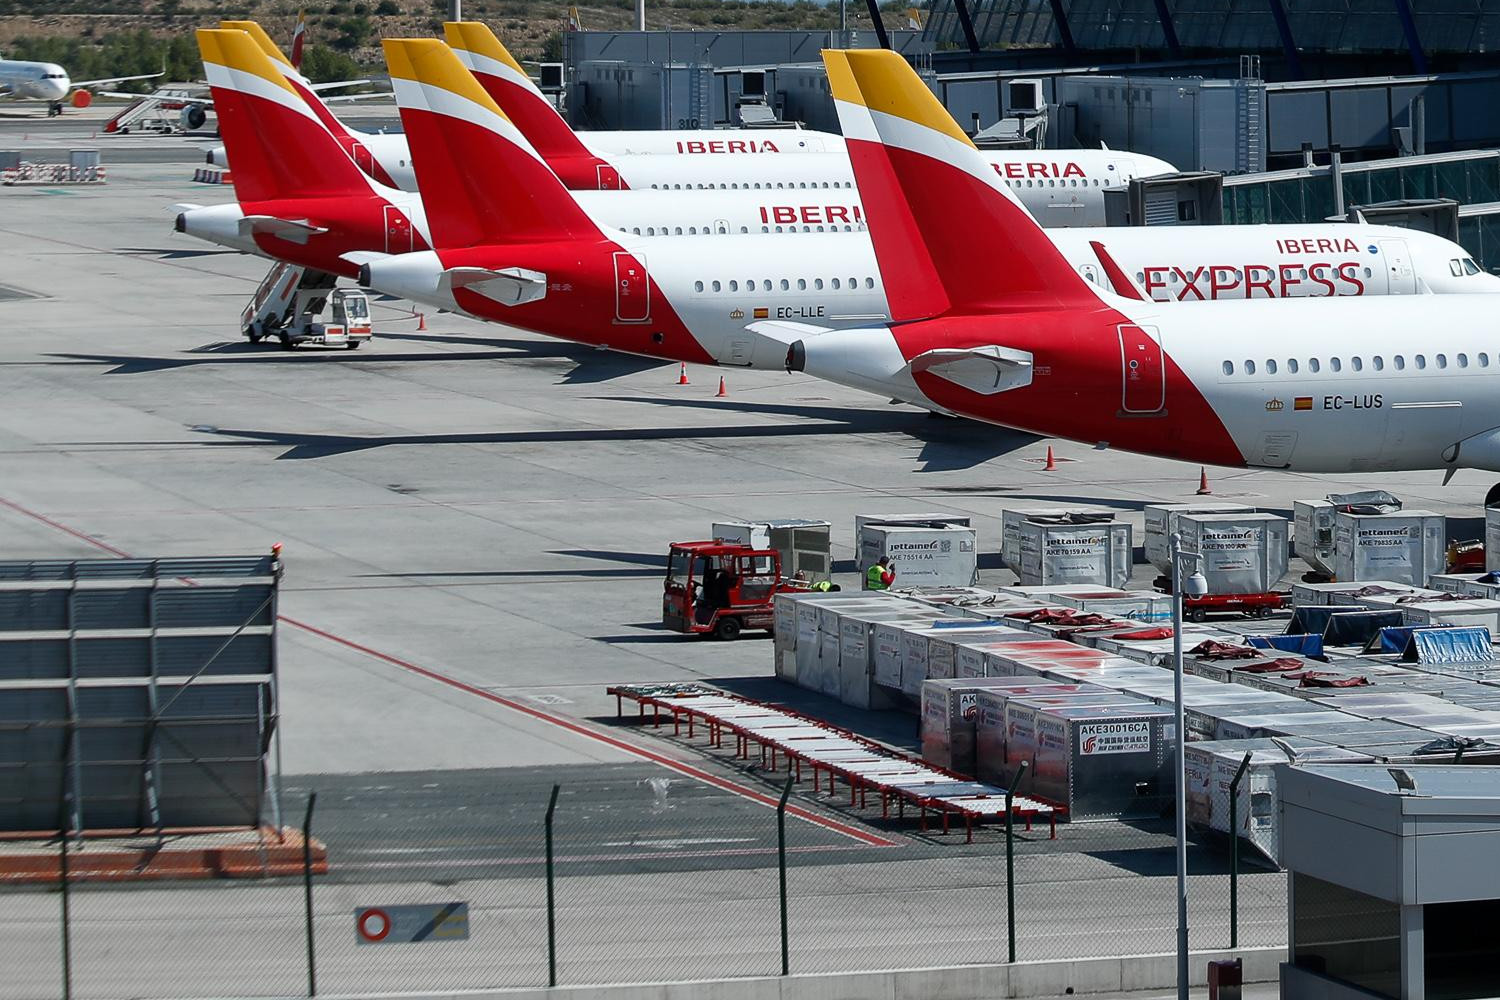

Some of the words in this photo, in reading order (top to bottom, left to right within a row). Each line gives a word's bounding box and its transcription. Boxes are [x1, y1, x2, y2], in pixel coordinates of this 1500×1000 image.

[678, 118, 699, 130] 310
[676, 140, 780, 154] IBERIA
[759, 205, 867, 225] IBERI
[1276, 238, 1360, 254] IBERIA
[1144, 262, 1365, 302] EXPRESS
[777, 306, 825, 319] EC-LLE
[1323, 394, 1383, 410] EC-LUS
[1081, 723, 1148, 735] AKE30016CA
